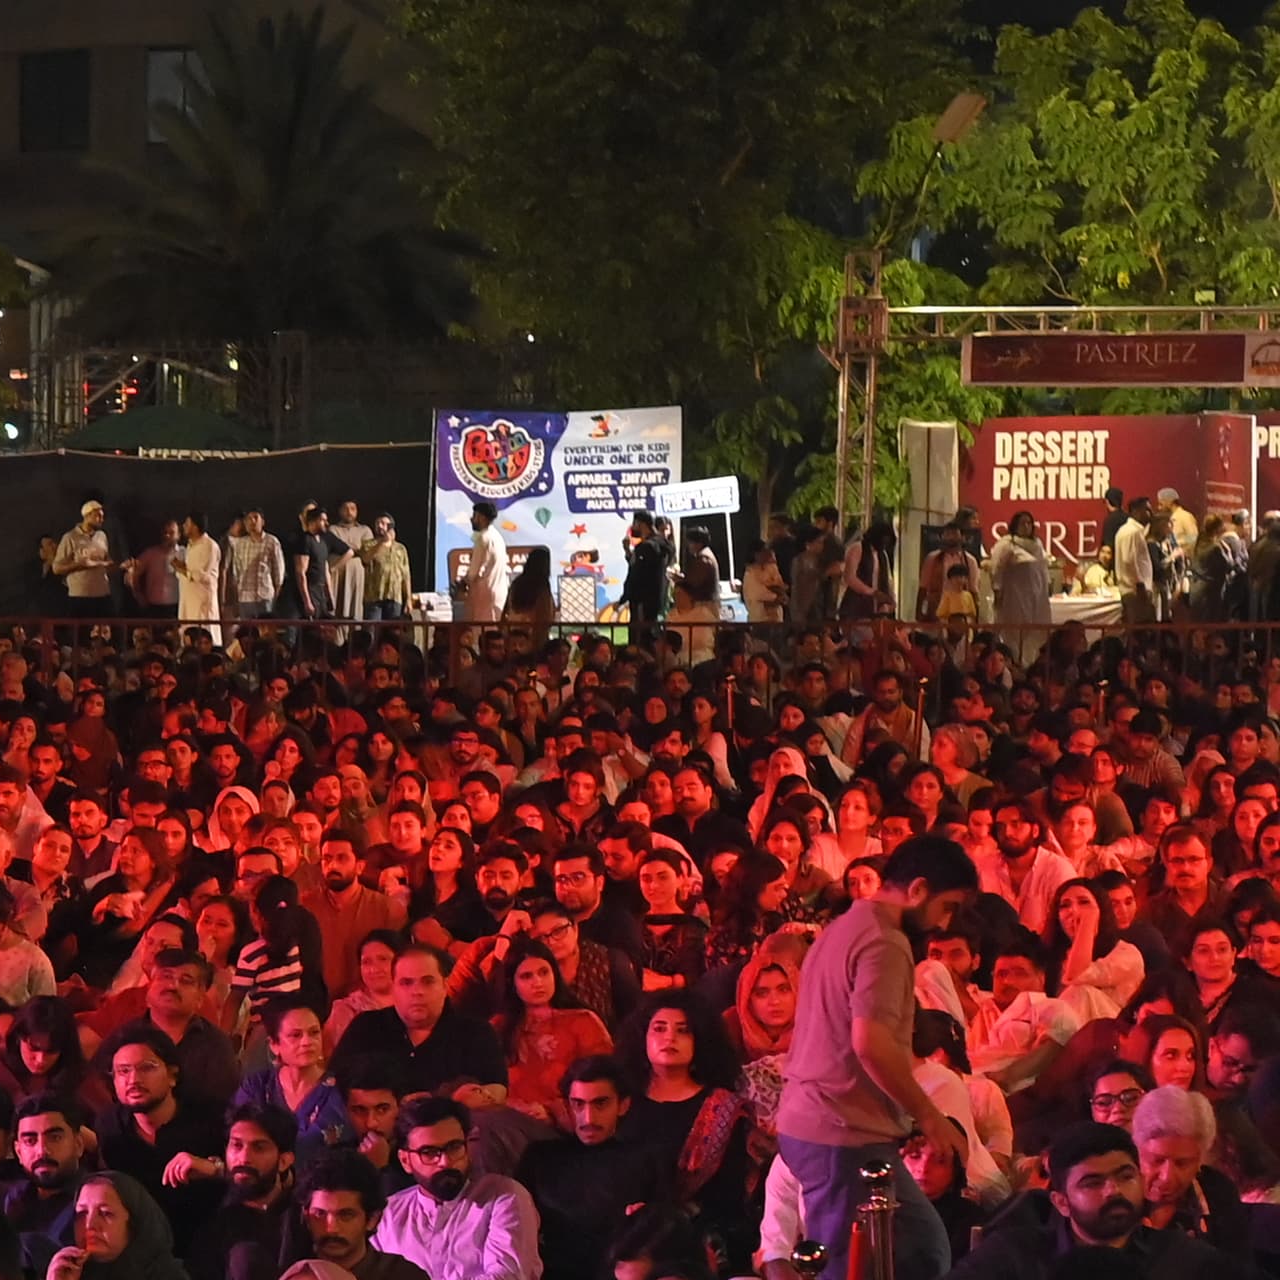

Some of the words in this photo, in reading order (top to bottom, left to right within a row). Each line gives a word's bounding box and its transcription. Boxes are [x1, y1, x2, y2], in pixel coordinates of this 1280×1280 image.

[1076, 343, 1197, 366] PASTREEZ
[564, 444, 623, 455] EVERYTHING
[626, 444, 644, 453] FOR
[647, 442, 670, 452] KIDS
[994, 430, 1109, 465] DESSERT
[564, 455, 604, 466] UNDER
[610, 454, 633, 464] ONE
[638, 453, 670, 464] ROOF
[993, 465, 1110, 500] PARTNER
[618, 486, 647, 498] TOYS
[586, 500, 615, 509] MUCH
[618, 499, 647, 509] MORE
